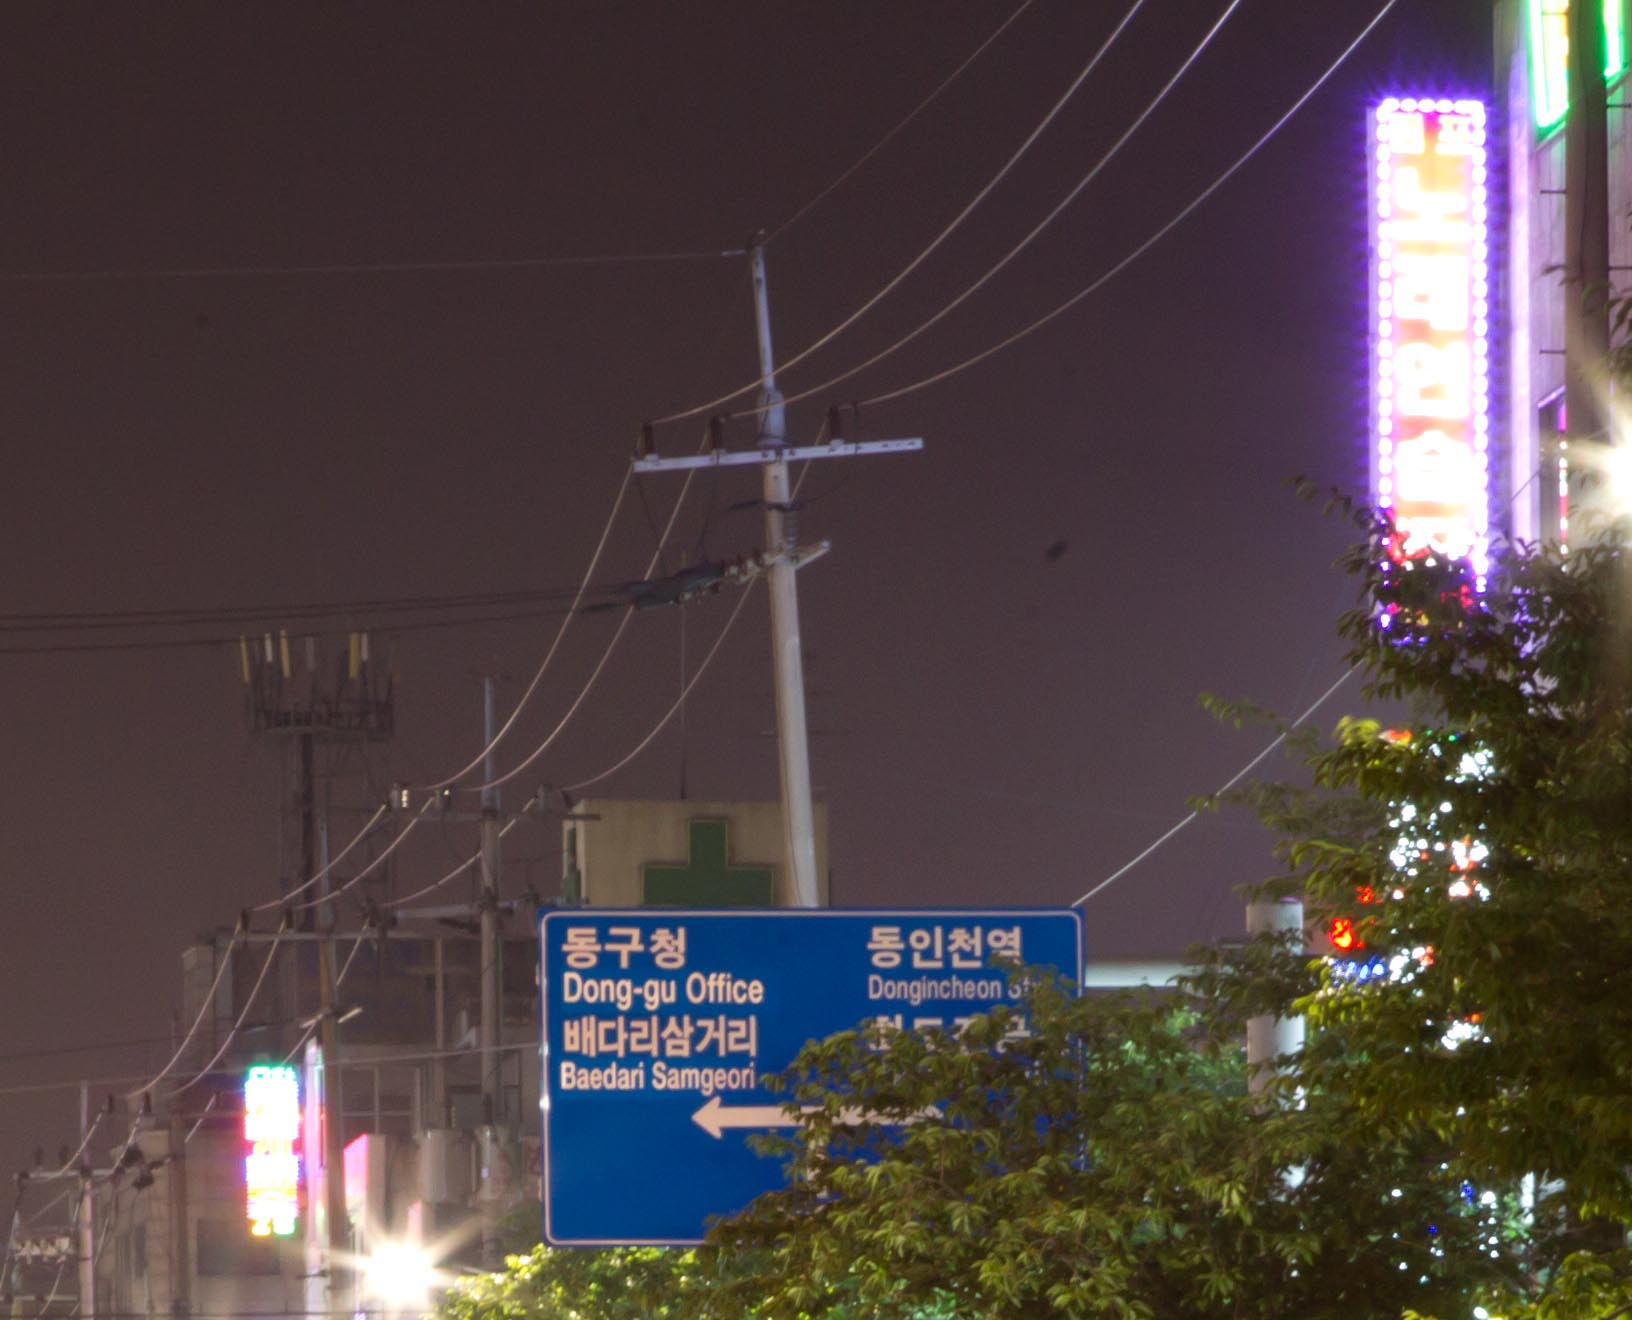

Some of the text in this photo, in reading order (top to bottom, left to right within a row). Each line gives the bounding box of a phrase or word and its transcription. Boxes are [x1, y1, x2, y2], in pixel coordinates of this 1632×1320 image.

[561, 926, 687, 969] 동구청
[866, 925, 1022, 969] 동인천역
[563, 971, 764, 1011] Dong-gu Office
[868, 974, 1002, 1006] Dongincheon
[563, 1014, 757, 1058] 배다리삼거리
[560, 1060, 756, 1097] Baedari Samgeori
